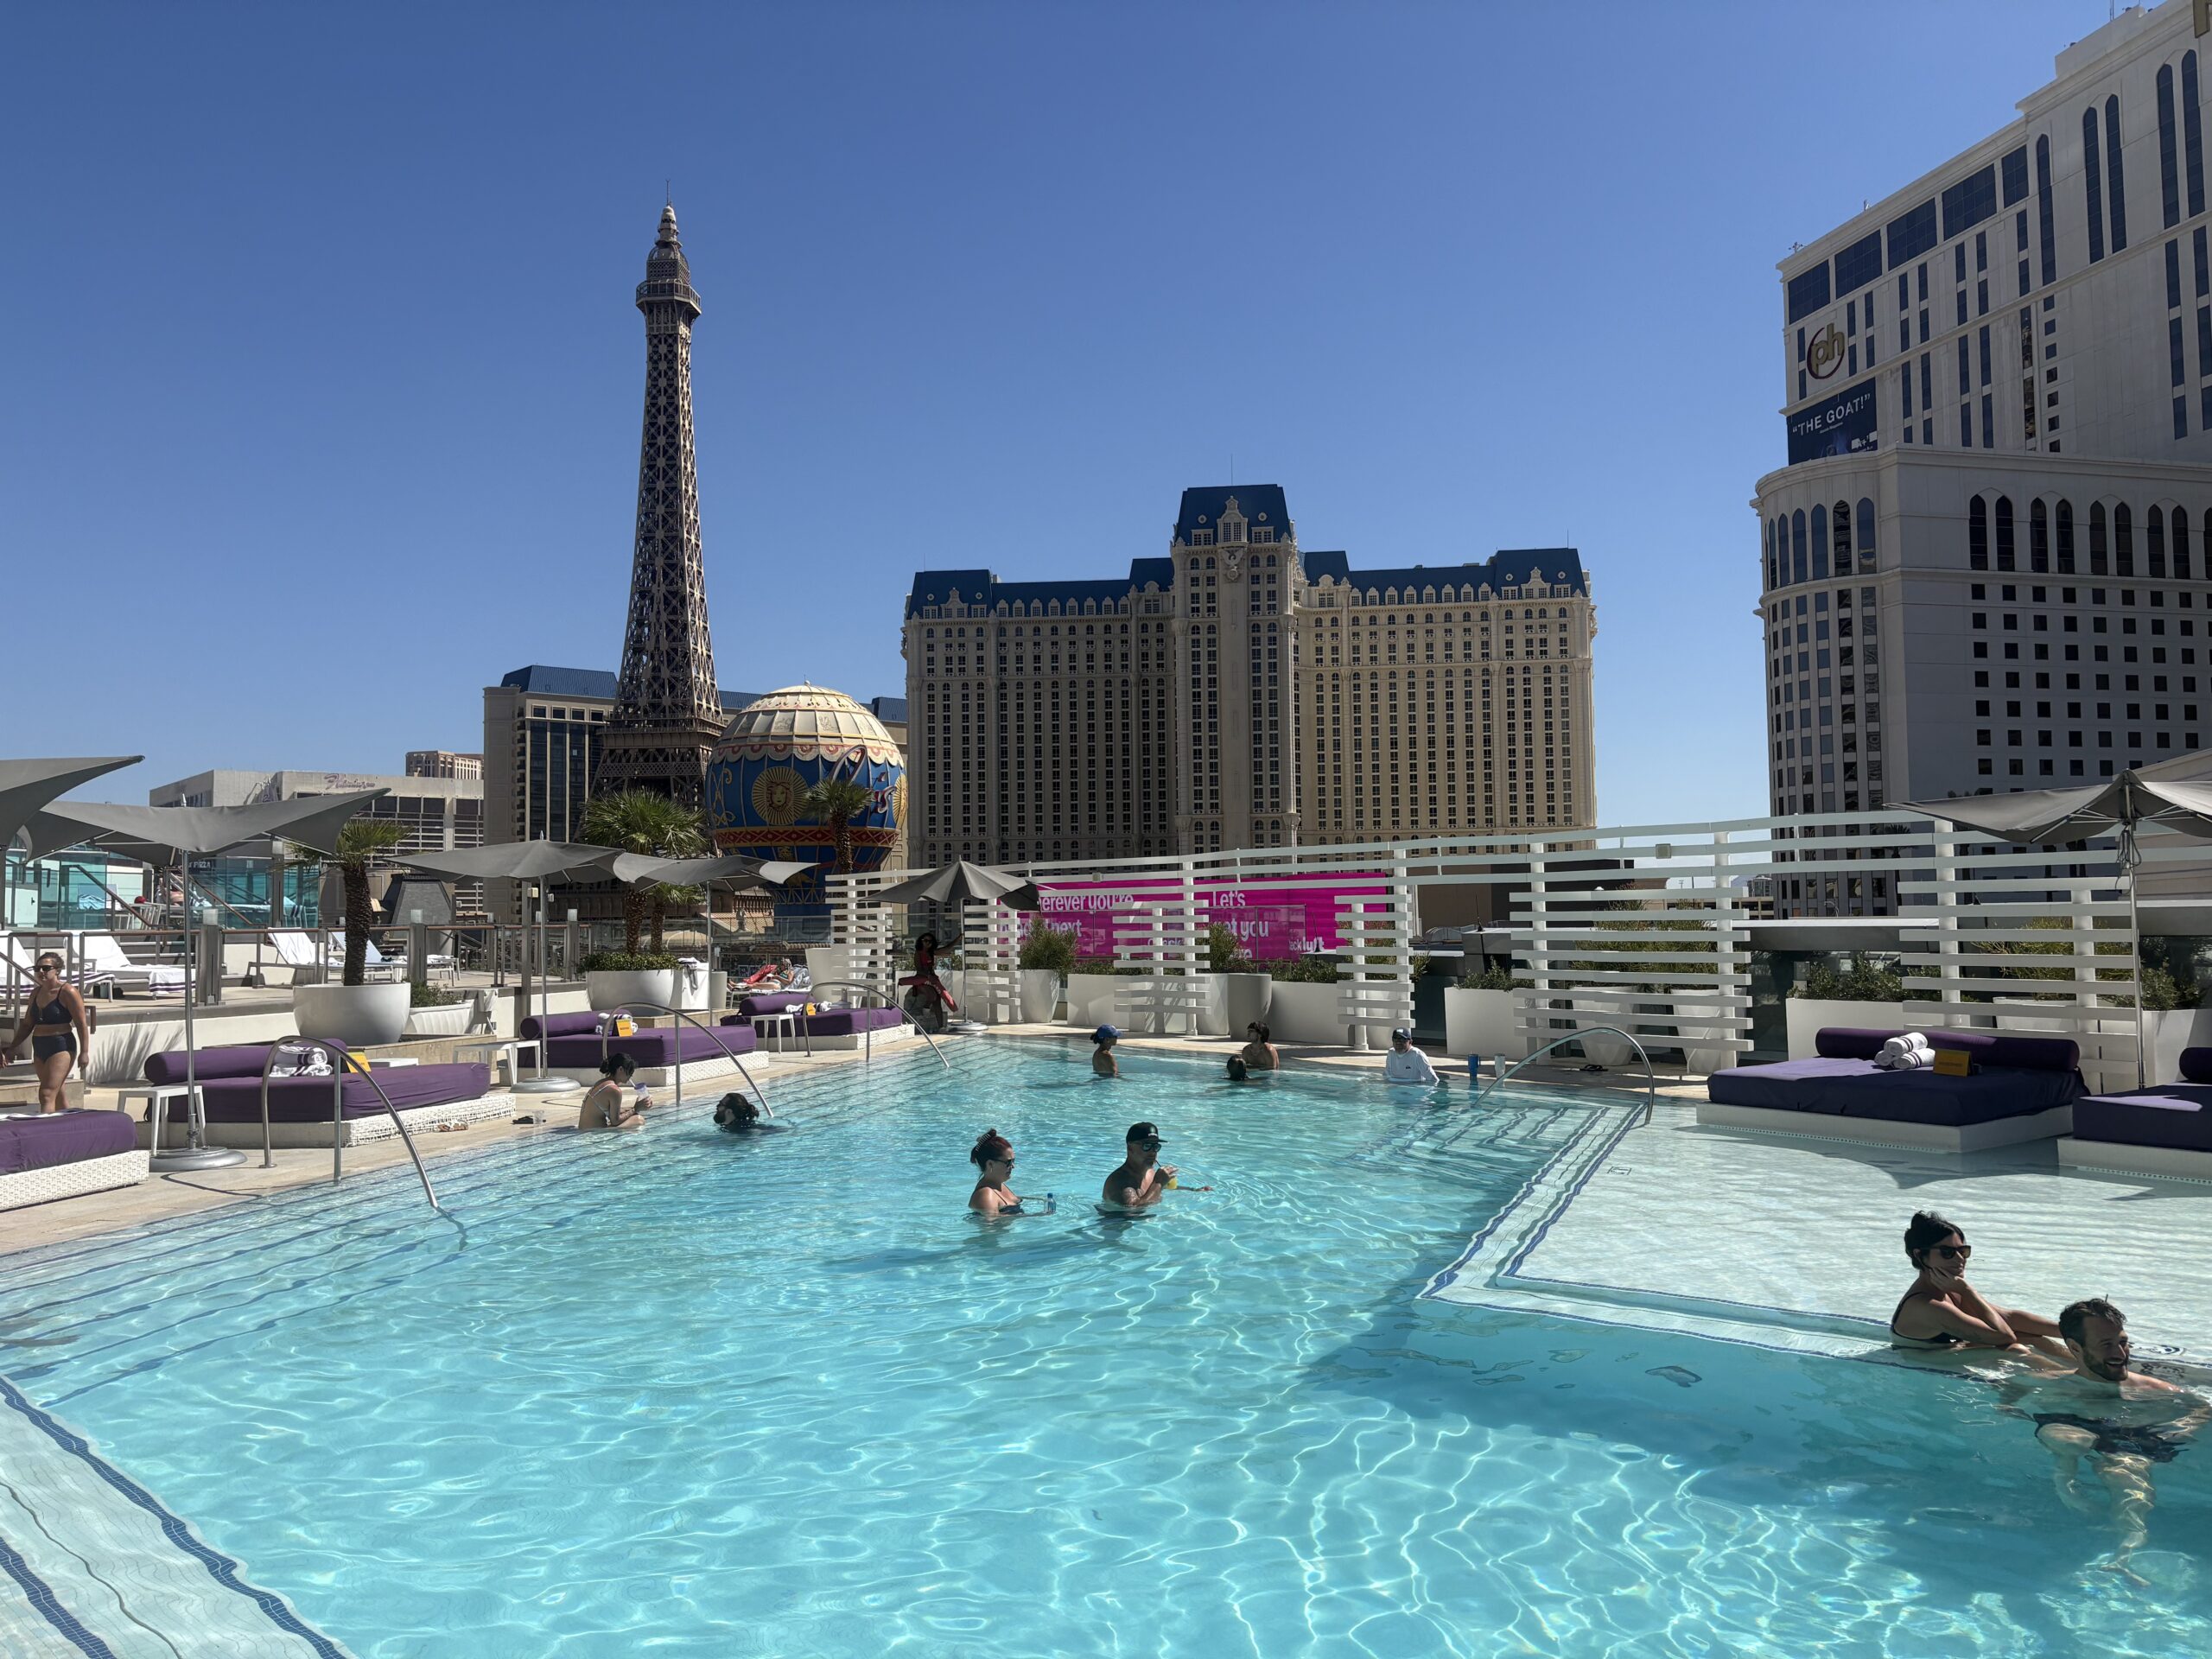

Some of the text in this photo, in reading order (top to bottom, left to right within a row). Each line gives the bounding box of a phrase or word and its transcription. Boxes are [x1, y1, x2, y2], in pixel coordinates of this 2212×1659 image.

[1810, 322, 1846, 375] ph
[1039, 895, 1086, 912] erever
[1212, 891, 1246, 909] Let's
